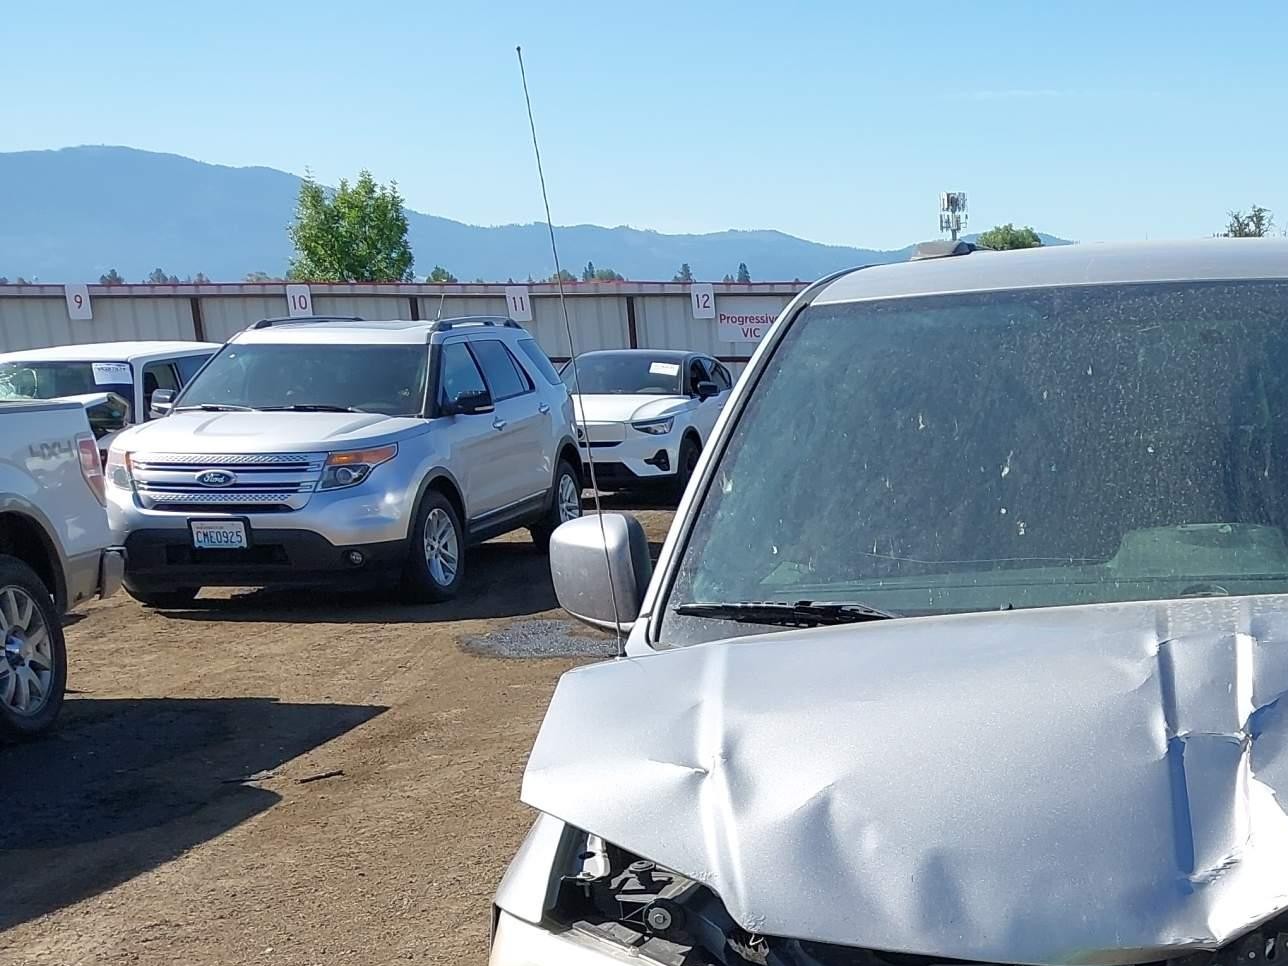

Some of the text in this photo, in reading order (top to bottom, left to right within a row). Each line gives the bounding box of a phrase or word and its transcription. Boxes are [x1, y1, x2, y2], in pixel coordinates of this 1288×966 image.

[73, 294, 83, 310] 9
[291, 294, 308, 310] 10
[512, 296, 525, 312] 11
[695, 294, 711, 309] 12
[741, 327, 761, 338] VIC
[203, 473, 225, 483] Ford
